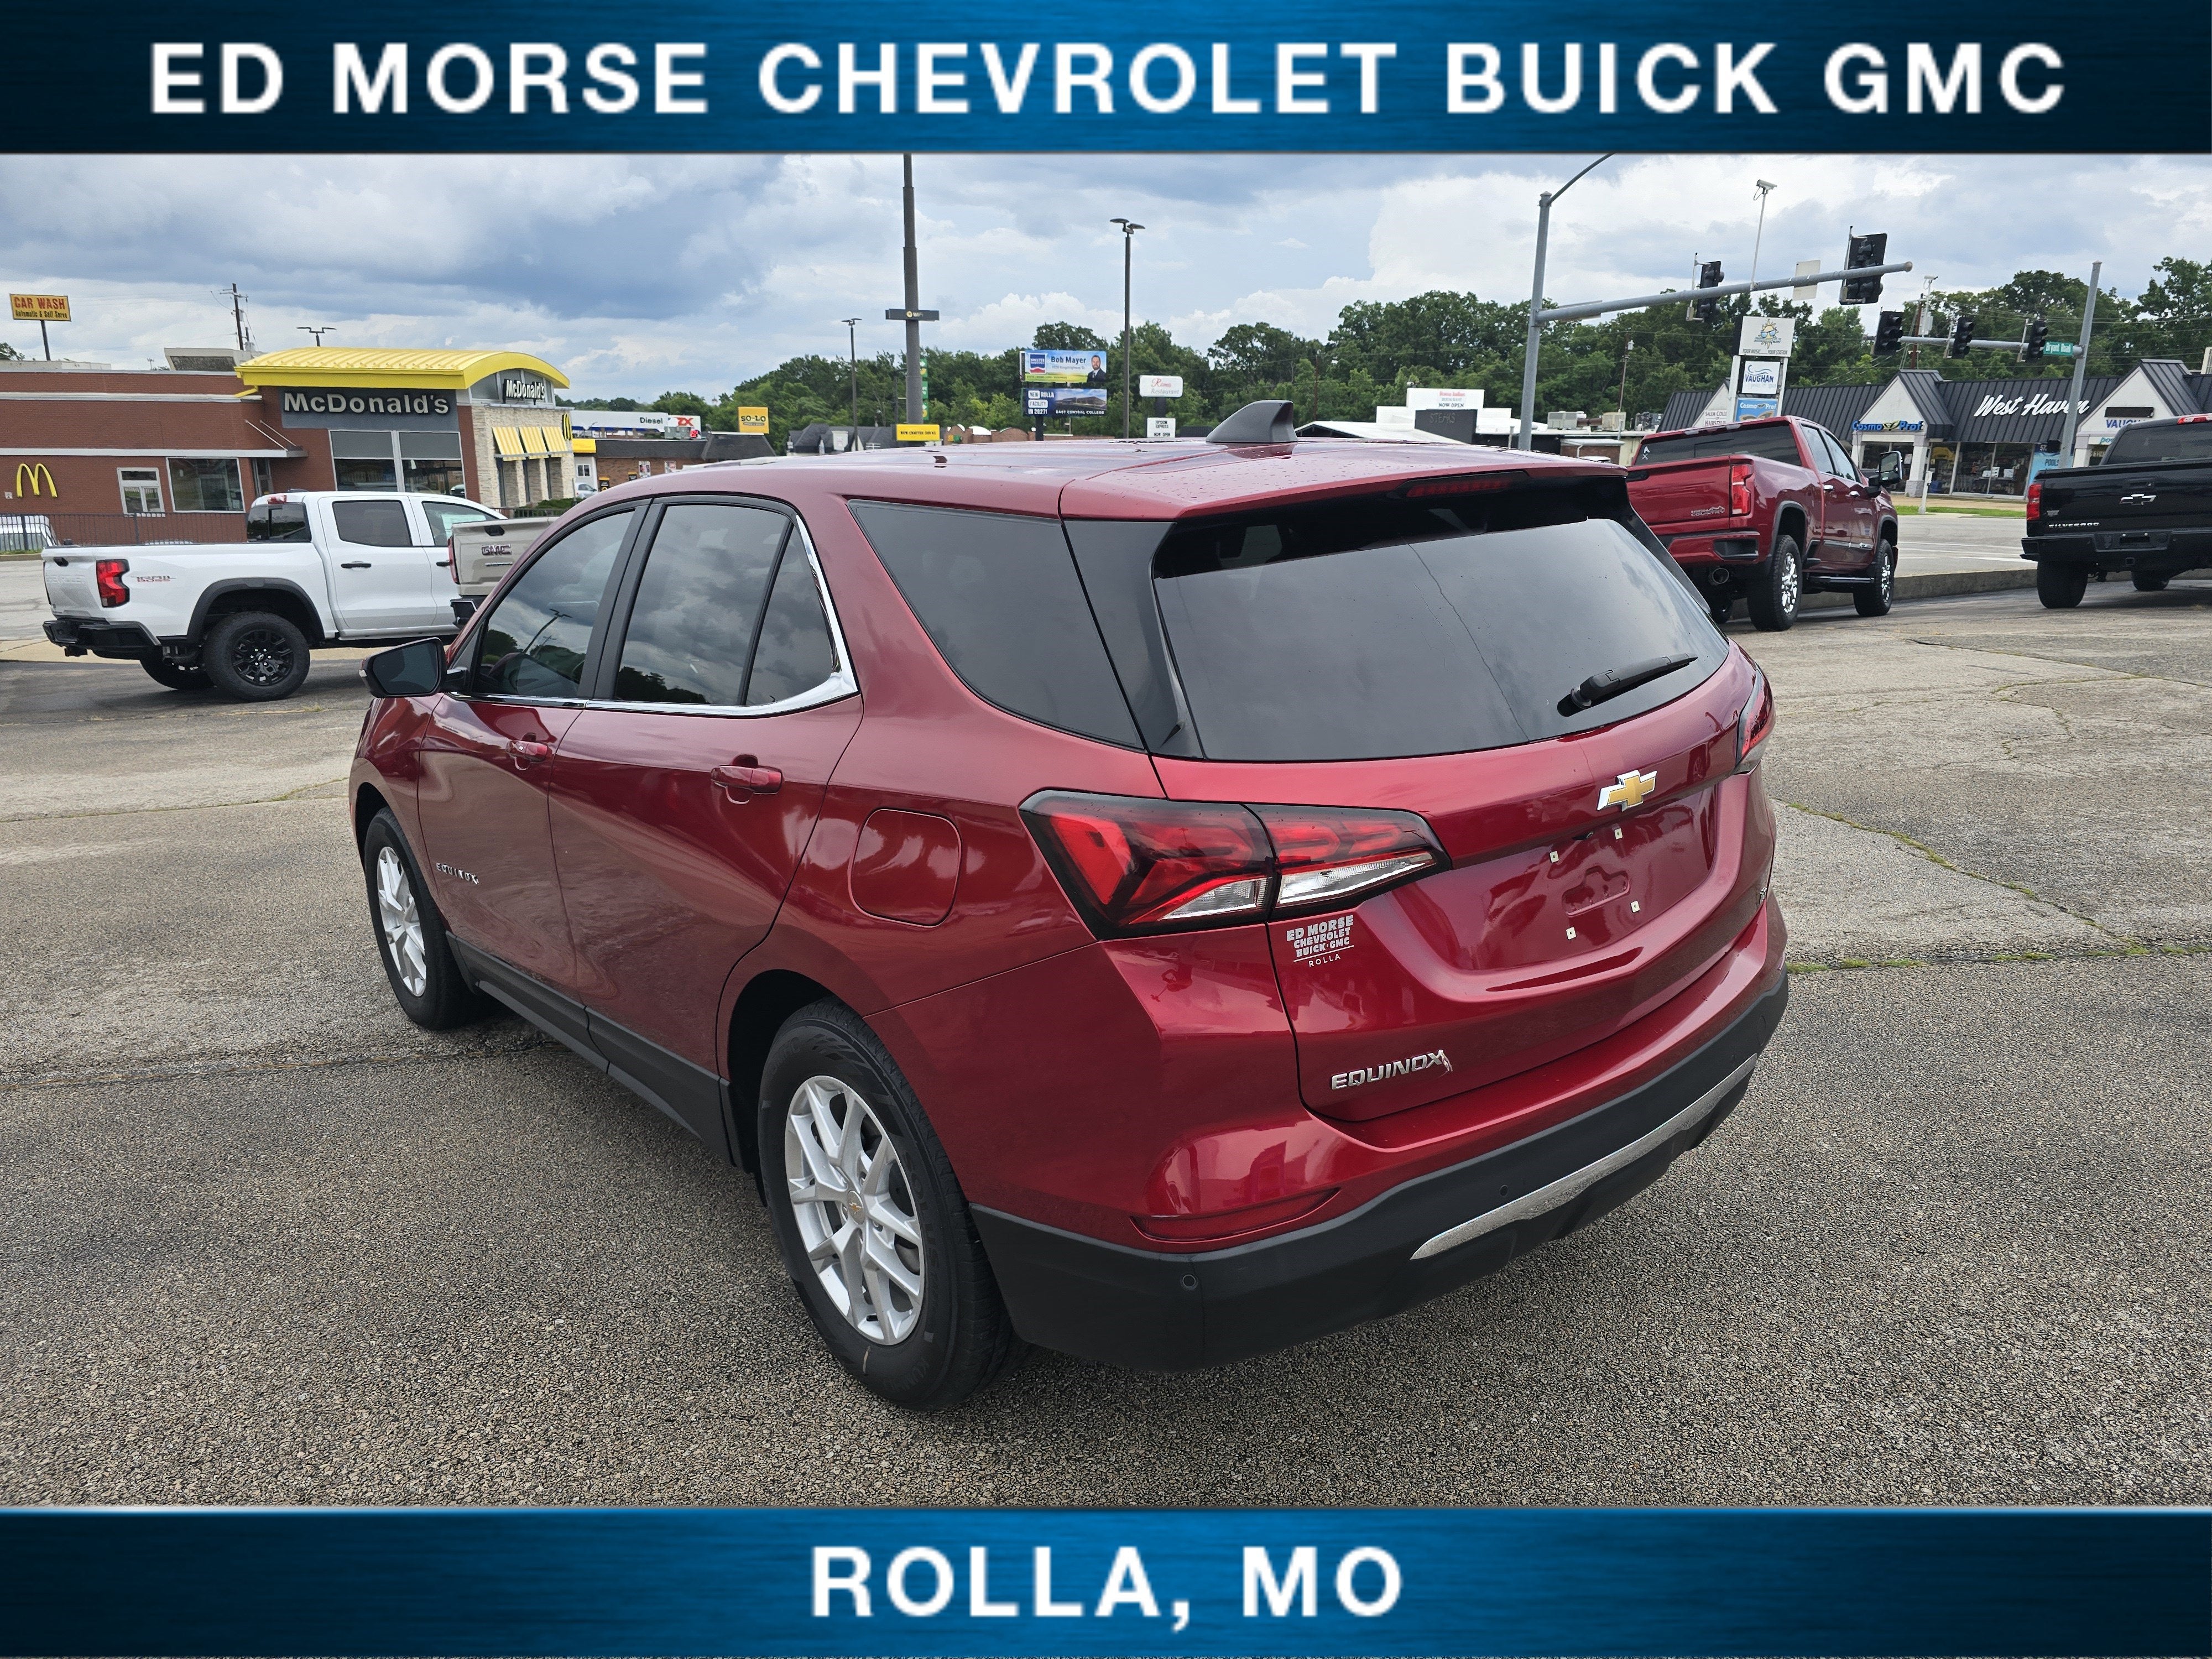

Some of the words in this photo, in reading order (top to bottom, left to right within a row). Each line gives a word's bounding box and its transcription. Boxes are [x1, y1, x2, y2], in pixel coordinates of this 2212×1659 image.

[14, 297, 33, 309] CAR
[36, 298, 65, 310] WASH
[1066, 357, 1086, 366] Mayer
[506, 379, 545, 399] McDonald's
[284, 393, 448, 414] McDonald's
[1974, 394, 2024, 416] West
[1852, 420, 1884, 431] Cosmo
[1900, 420, 1924, 430] Prof
[482, 545, 512, 555] GMC
[436, 862, 479, 885] EQUINOX
[1286, 927, 1305, 941] ED
[1308, 915, 1354, 936] MORSE
[1293, 927, 1350, 948] CHEVROLET
[1308, 953, 1341, 967] ROLLA
[1332, 1049, 1453, 1090] EQUINOX
